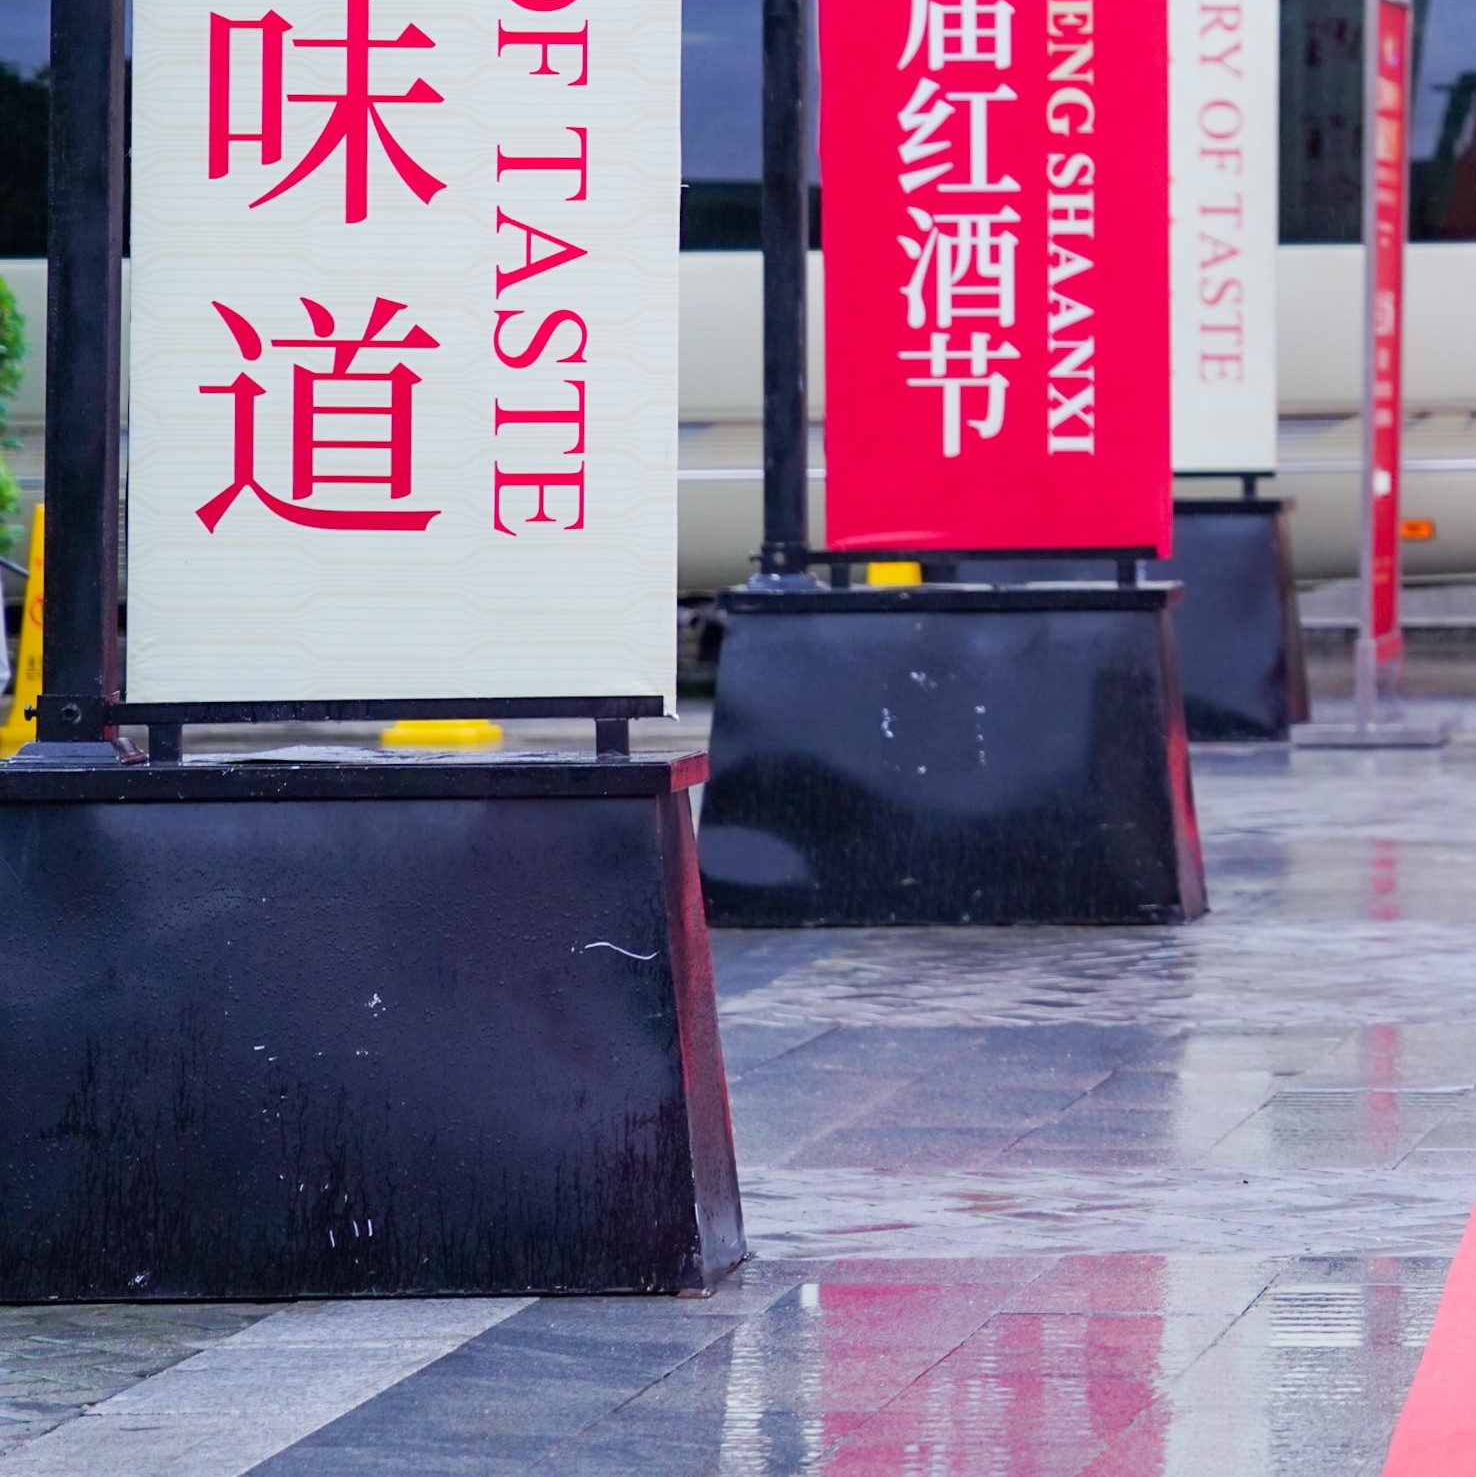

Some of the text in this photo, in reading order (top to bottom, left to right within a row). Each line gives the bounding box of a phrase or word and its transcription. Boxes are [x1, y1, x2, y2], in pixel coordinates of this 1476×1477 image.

[1199, 97, 1244, 176] OF
[493, 126, 588, 536] TASTE
[1047, 153, 1095, 453] SHAANXI
[1199, 194, 1245, 384] TASTE
